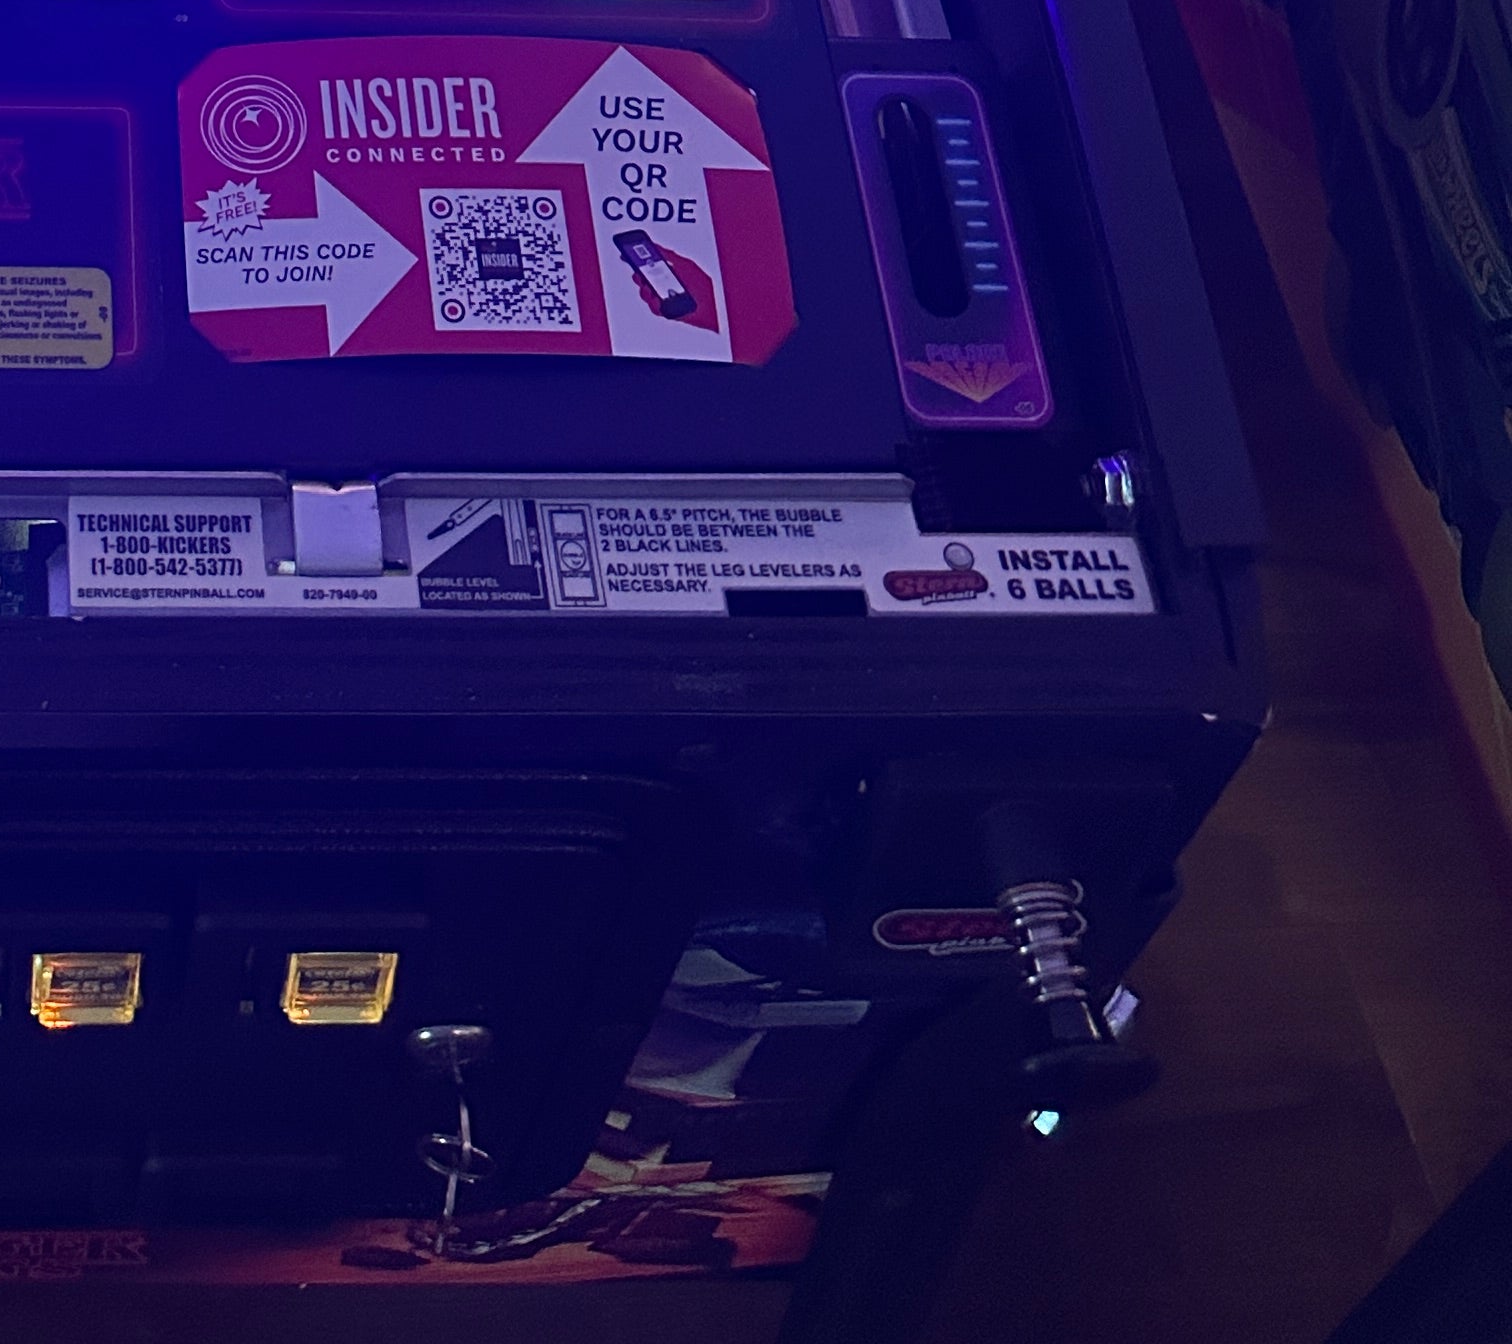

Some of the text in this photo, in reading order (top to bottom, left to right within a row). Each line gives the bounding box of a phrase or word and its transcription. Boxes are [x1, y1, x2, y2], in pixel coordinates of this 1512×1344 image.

[319, 76, 503, 140] INSIDER
[599, 95, 666, 121] USE
[591, 127, 684, 155] YOUR
[325, 147, 507, 164] CONNECTED
[620, 162, 668, 194] QR
[217, 191, 247, 210] IT'S
[601, 195, 698, 224] CODE
[215, 200, 258, 224] FREE!
[196, 243, 376, 264] SCAN THIS CODE
[480, 252, 520, 268] INSIDER
[10, 276, 67, 286] SEIZURES
[242, 265, 334, 285] TO JOIN!
[77, 514, 253, 534] TECHNICAL SUPPORT
[595, 507, 632, 522] FOR
[634, 508, 648, 522] A
[683, 508, 735, 525] PITCH,
[738, 509, 771, 523] THE
[775, 509, 843, 524] BUBBLE
[598, 523, 816, 538] SHOULD BE BETWEEN THE
[100, 536, 232, 555] 1-800-KICKERS
[600, 539, 729, 554] 2 BLACK LINES.
[91, 558, 244, 577] (1-800-542-5377)
[998, 549, 1130, 572] INSTALL
[605, 564, 862, 578] ADJUST THE LEG LEVELERS AS
[421, 578, 499, 588] BUBBLE LEVEL
[607, 579, 712, 593] NECESSARY.
[1007, 578, 1136, 600] 6 BALLS
[77, 587, 266, 600] SERVICE@STERNPINBALL.COM
[421, 591, 472, 602] LOCATED
[491, 591, 532, 602] SHOWN
